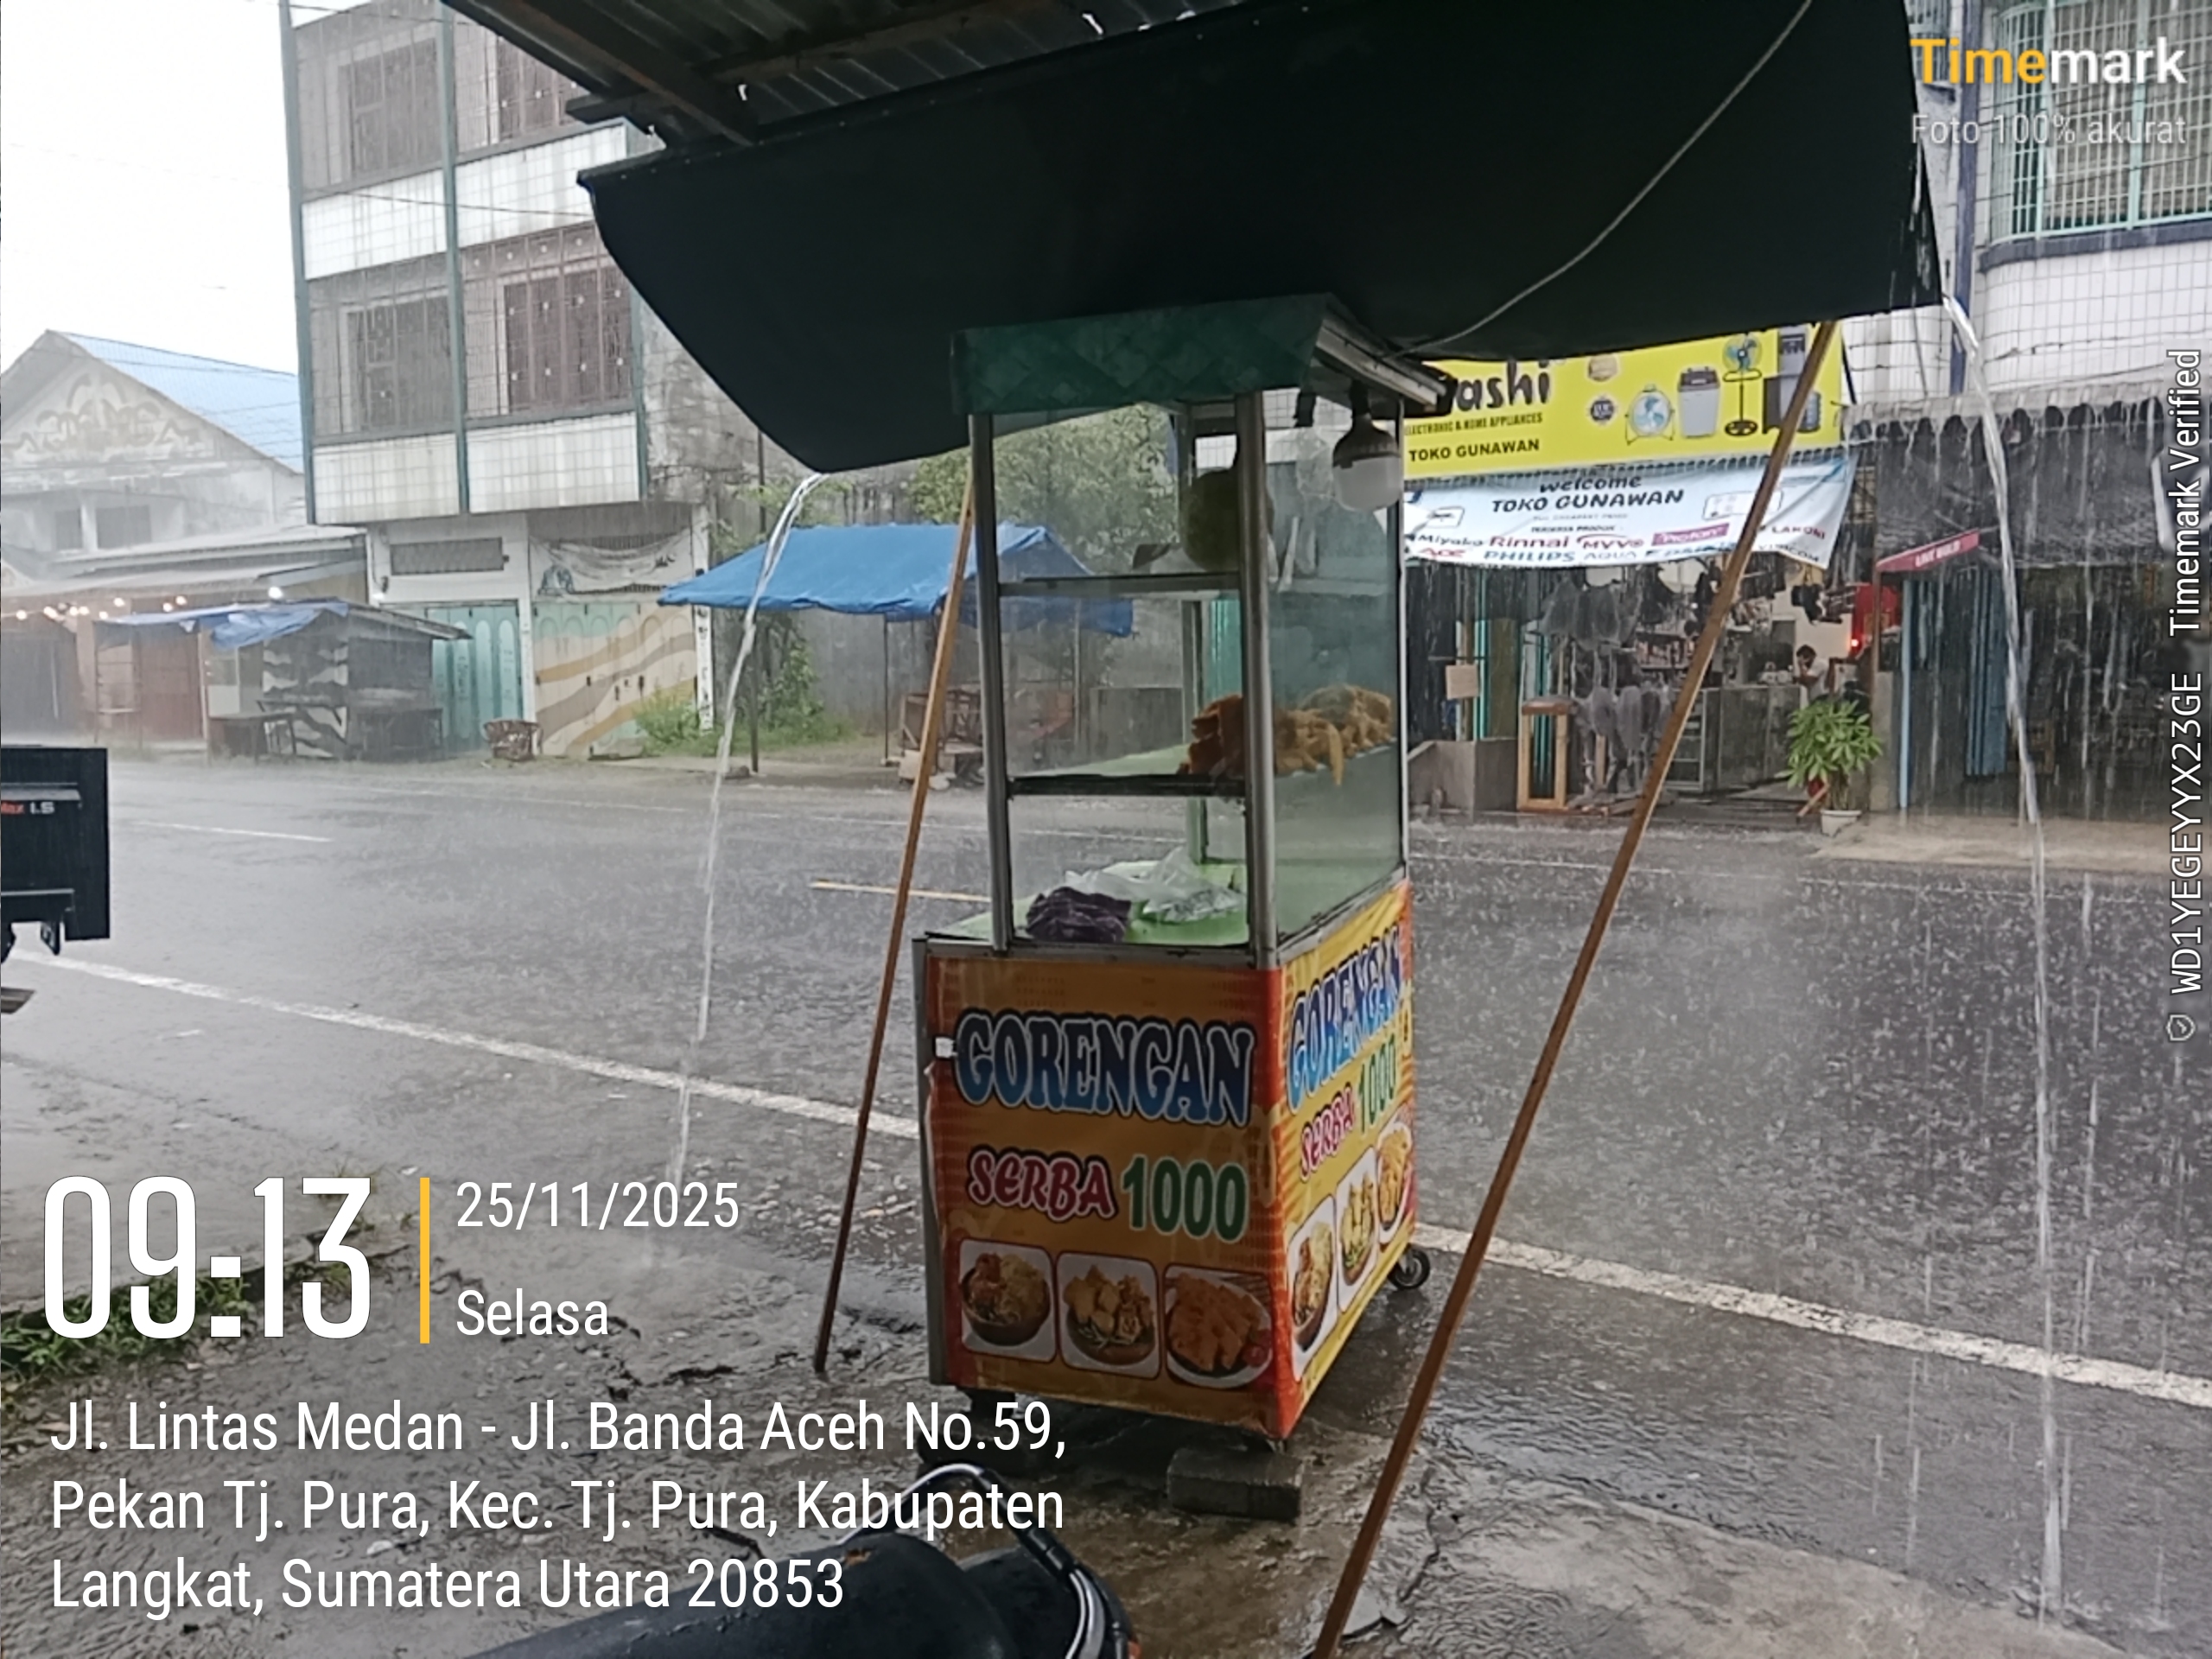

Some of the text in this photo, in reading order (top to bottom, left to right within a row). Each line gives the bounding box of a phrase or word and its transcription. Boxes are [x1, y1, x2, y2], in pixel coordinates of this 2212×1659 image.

[1452, 359, 1551, 411] ashi
[1464, 417, 1487, 429] HOME
[1490, 411, 1544, 427] APPLIANCES
[1408, 438, 1541, 462] TOKO GUNAWAN
[1539, 476, 1642, 493] welcome
[1491, 488, 1684, 513] TOKO GUNAWAN
[1489, 535, 1570, 550] Rinnai
[1484, 550, 1575, 563] PHILIPS
[1286, 925, 1402, 1116] GORENGAN
[954, 1009, 1255, 1126] GORENGAN
[1300, 1033, 1398, 1183] SERBA 1000
[968, 1145, 1249, 1243] SERBA 1000
